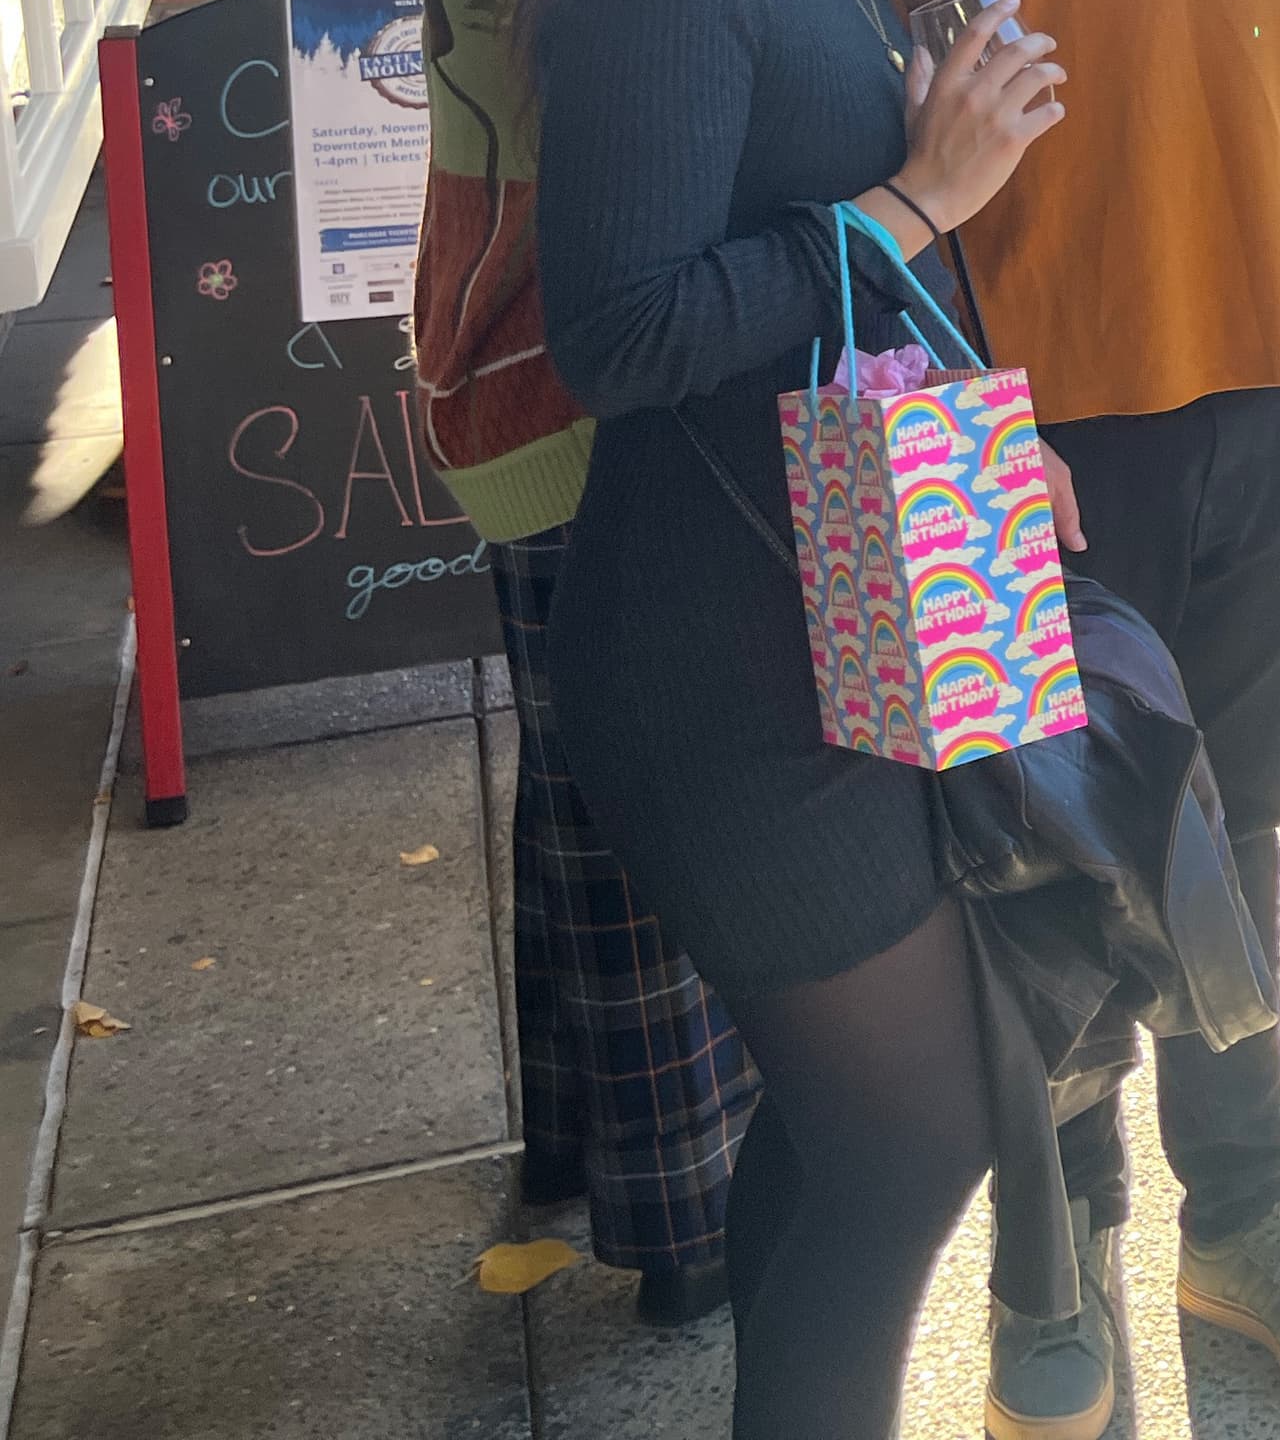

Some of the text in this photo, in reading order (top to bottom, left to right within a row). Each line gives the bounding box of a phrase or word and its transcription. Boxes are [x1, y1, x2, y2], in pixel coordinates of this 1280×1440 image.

[311, 124, 378, 138] Saturday,
[312, 139, 387, 153] Downtown
[373, 151, 421, 164] Tickets
[207, 171, 293, 208] our
[896, 419, 940, 443] HAPPY
[909, 503, 955, 529] HAPPY
[344, 538, 492, 620] good
[922, 587, 972, 614] HAPPY
[937, 671, 987, 698] HAPPY
